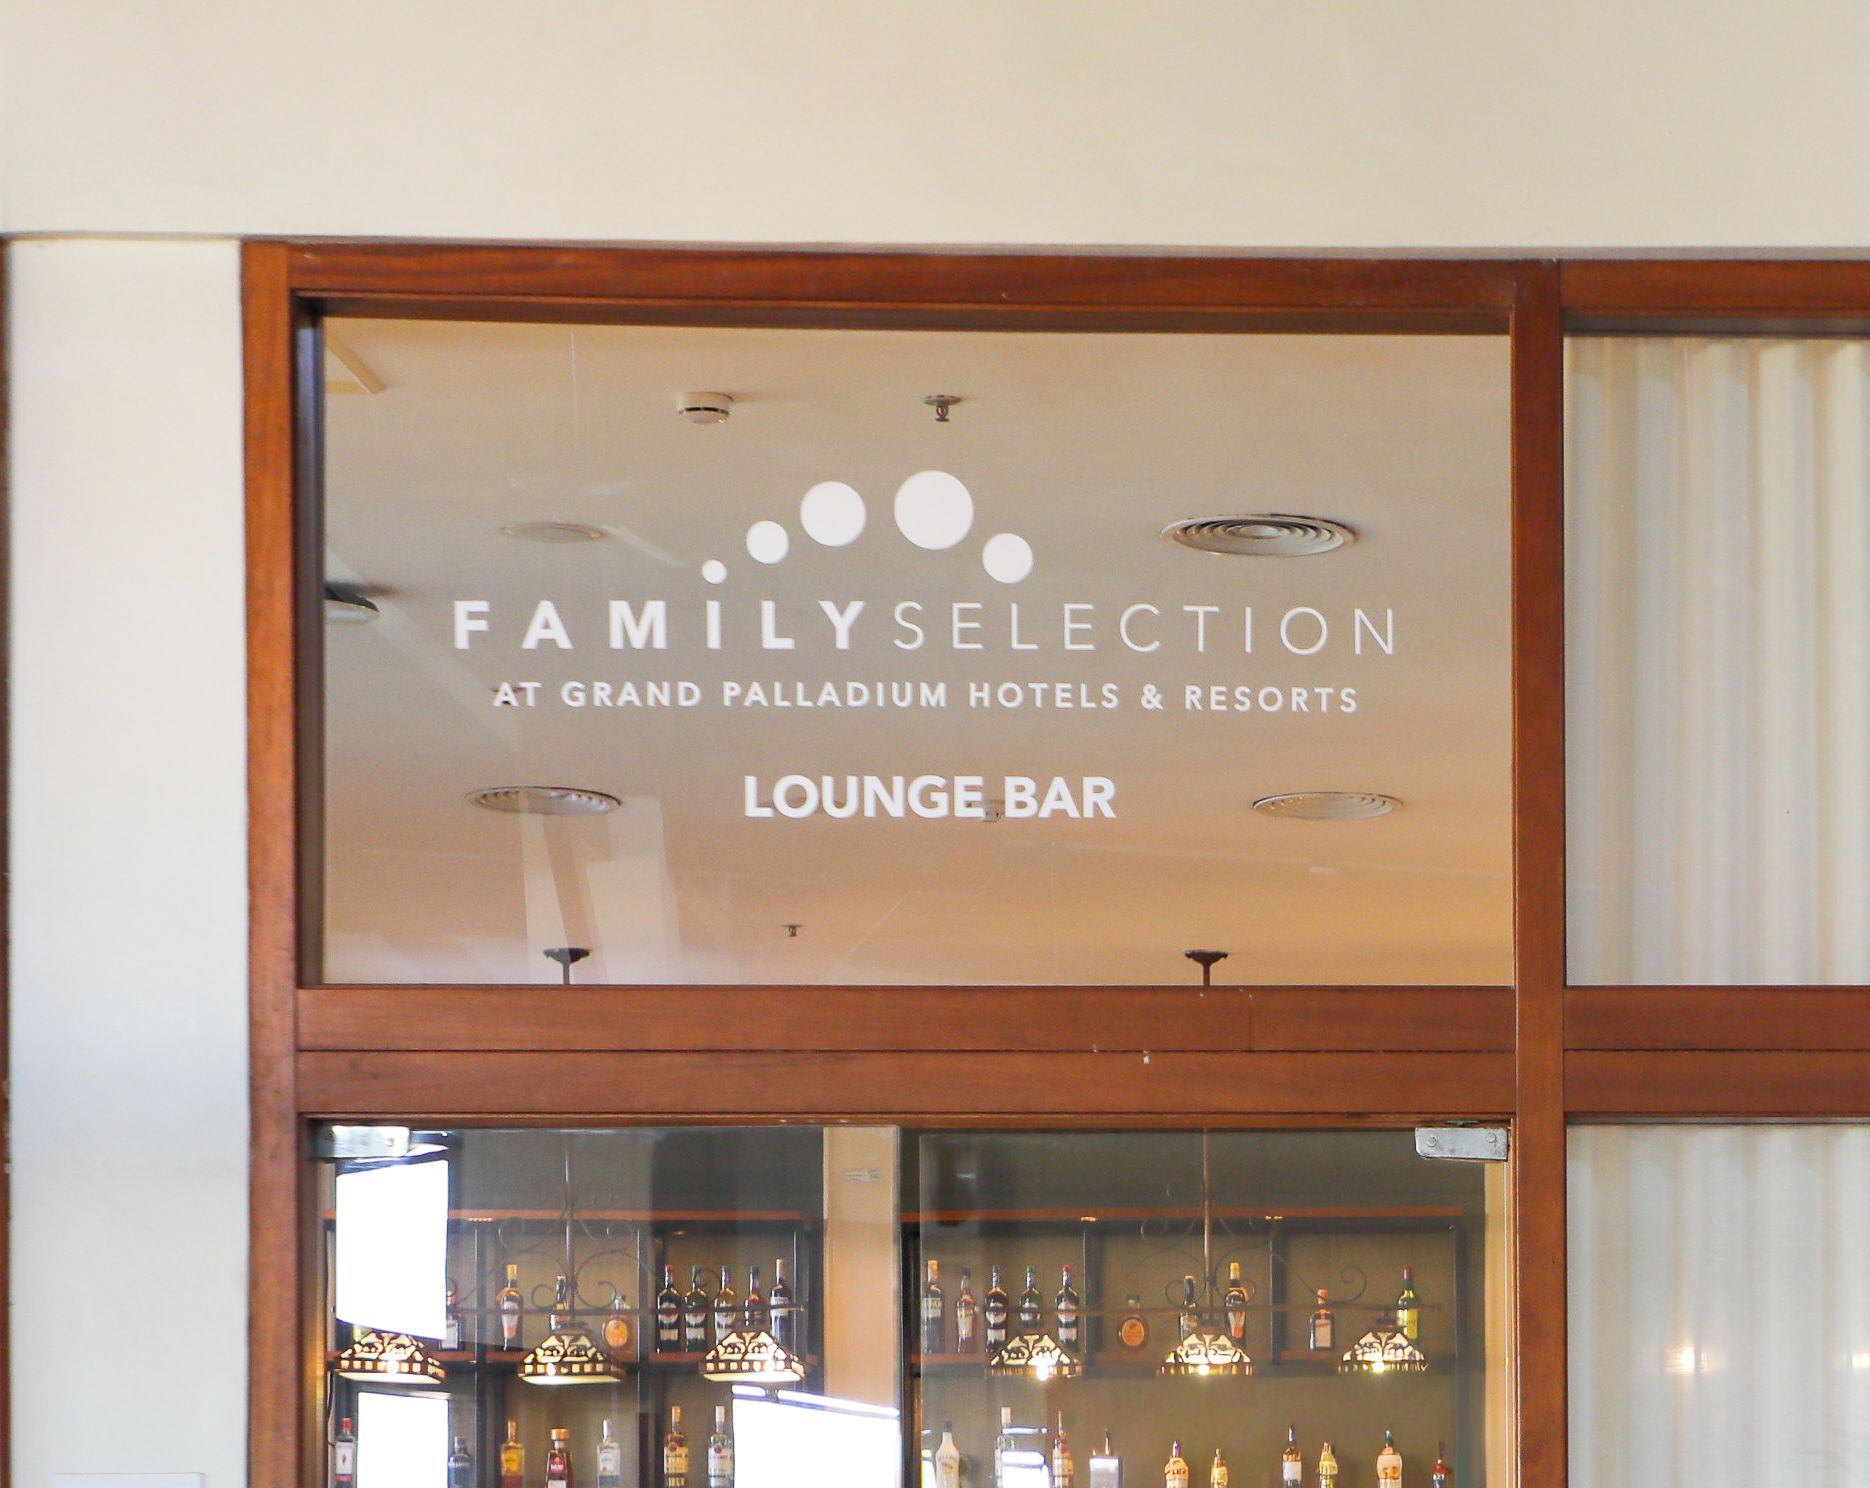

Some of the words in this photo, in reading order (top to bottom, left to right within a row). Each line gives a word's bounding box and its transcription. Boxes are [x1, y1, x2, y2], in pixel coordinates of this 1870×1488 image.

[493, 681, 543, 708] AT
[560, 680, 702, 708] GRAND
[722, 681, 947, 709] PALLADIUM
[969, 682, 1120, 710] HOTELS
[1140, 683, 1164, 711] &
[1184, 684, 1358, 714] RESORTS
[744, 774, 987, 821] LOUNGE
[1004, 775, 1118, 819] BAR
